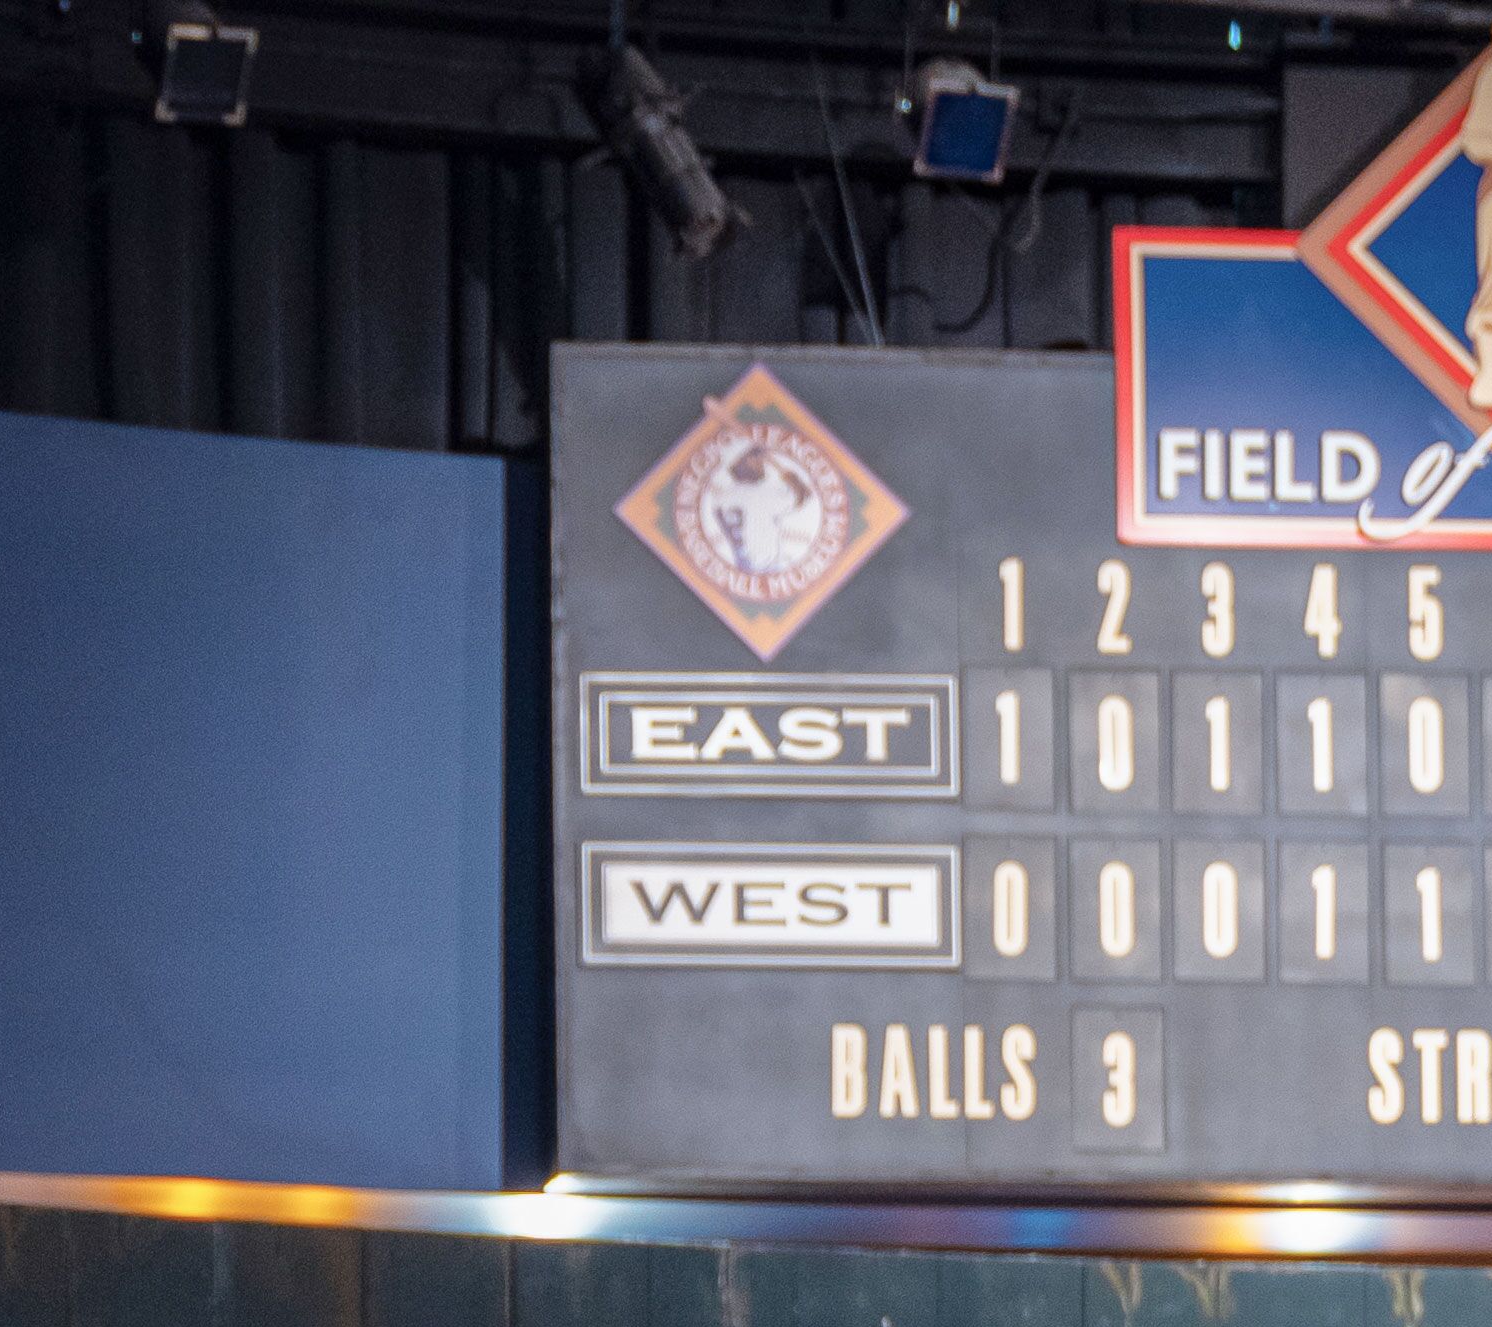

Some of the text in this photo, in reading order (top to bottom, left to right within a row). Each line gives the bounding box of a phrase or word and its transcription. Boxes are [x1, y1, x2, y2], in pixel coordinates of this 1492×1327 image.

[1158, 429, 1381, 503] FIELD
[999, 557, 1024, 652] 1
[1098, 560, 1132, 654] 2
[1202, 561, 1235, 657] 3
[1304, 562, 1341, 658] 4
[1409, 564, 1444, 661] 5
[628, 706, 911, 763] EAST
[995, 690, 1020, 785] 1
[1098, 694, 1134, 791] 0
[1205, 696, 1230, 791] 1
[1307, 697, 1334, 792] 1
[1408, 696, 1444, 793] 0
[630, 881, 913, 926] WEST
[993, 860, 1028, 957] 0
[1099, 861, 1135, 958] 0
[1203, 861, 1238, 960] 0
[1311, 863, 1336, 962] 1
[1417, 866, 1442, 963] 1
[831, 1022, 1038, 1121] BALLS
[1102, 1031, 1137, 1127] 3
